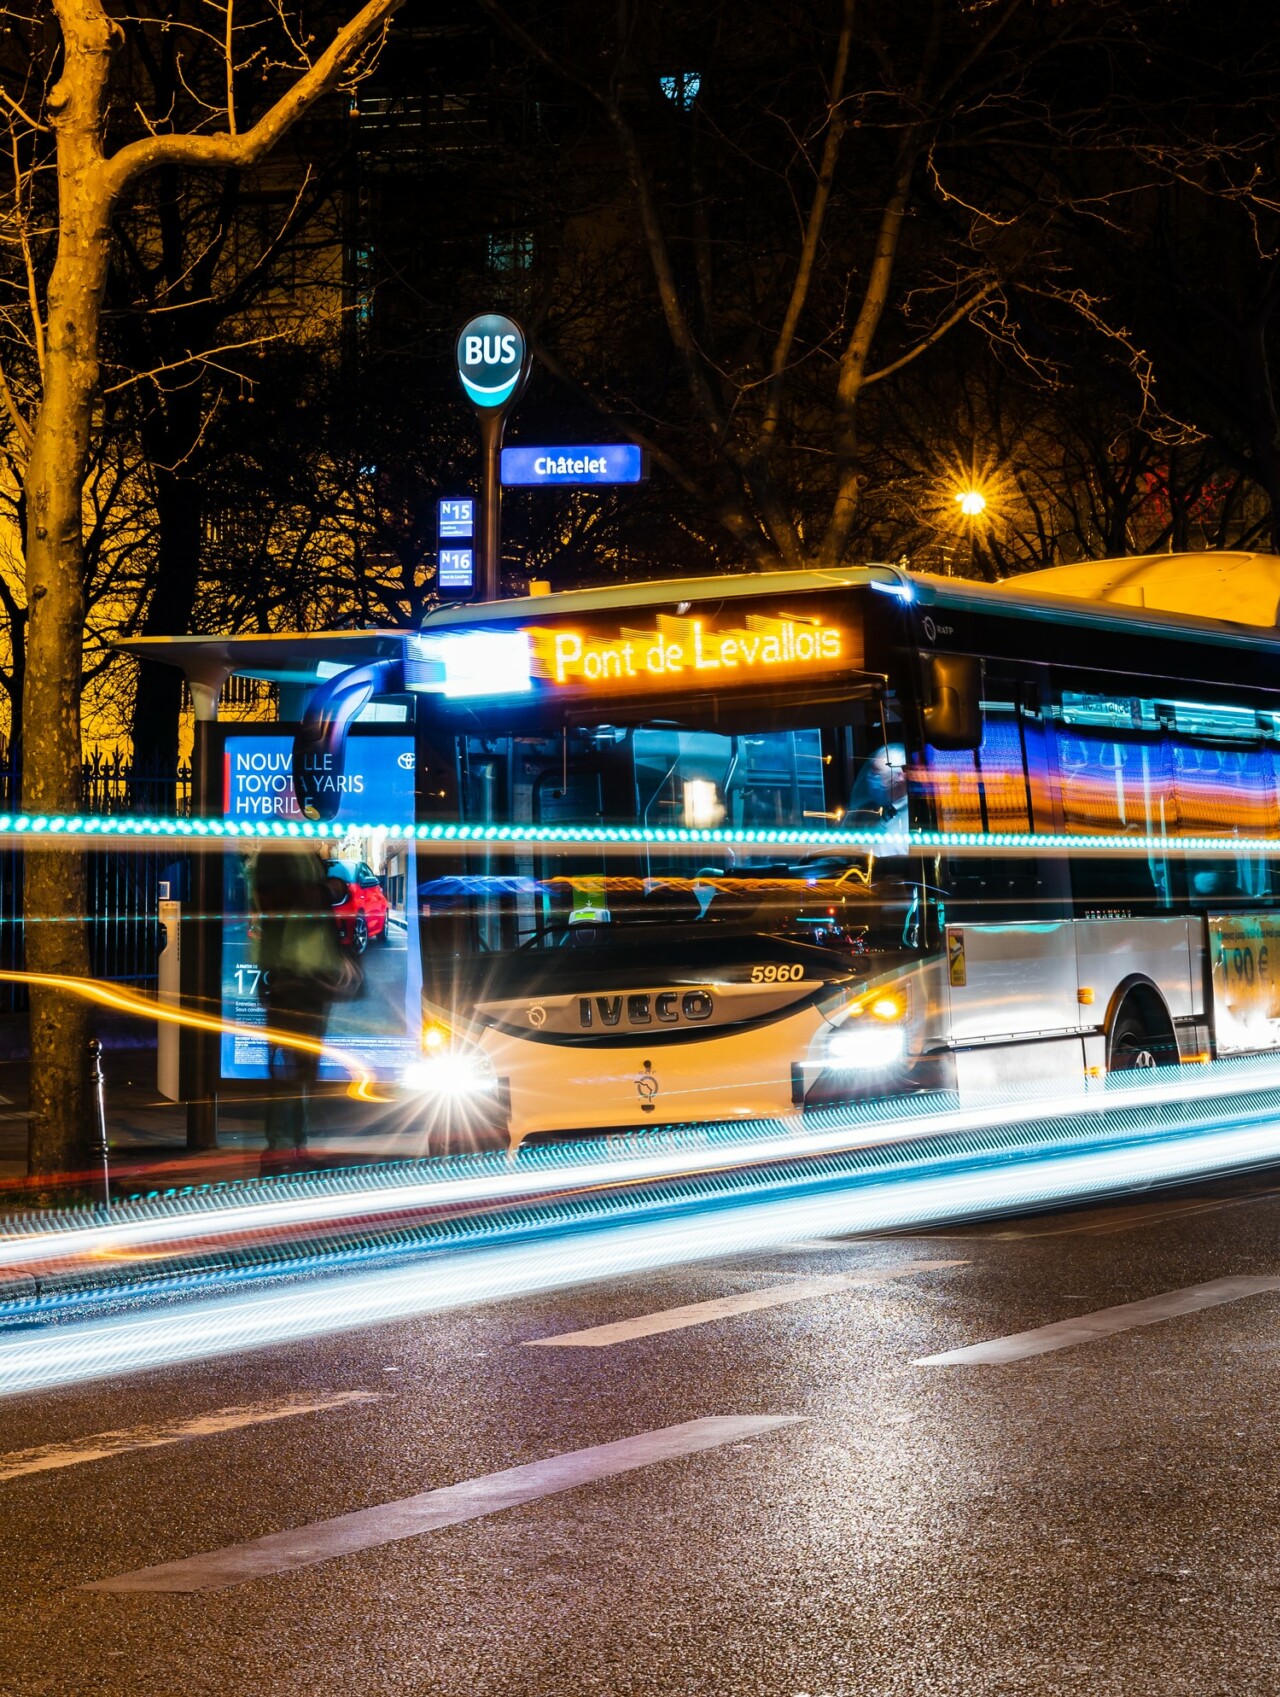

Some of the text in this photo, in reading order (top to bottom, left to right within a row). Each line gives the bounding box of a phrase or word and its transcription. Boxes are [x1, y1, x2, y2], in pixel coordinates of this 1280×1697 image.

[465, 334, 516, 365] BUS
[534, 456, 607, 475] Châtelet
[555, 620, 841, 682] Pont de Levallois
[236, 753, 333, 771] NOUVLLE
[313, 774, 364, 793] YARIS
[236, 796, 314, 814] HYBRIDE
[750, 964, 804, 984] 5960
[578, 990, 714, 1027] IVECO
